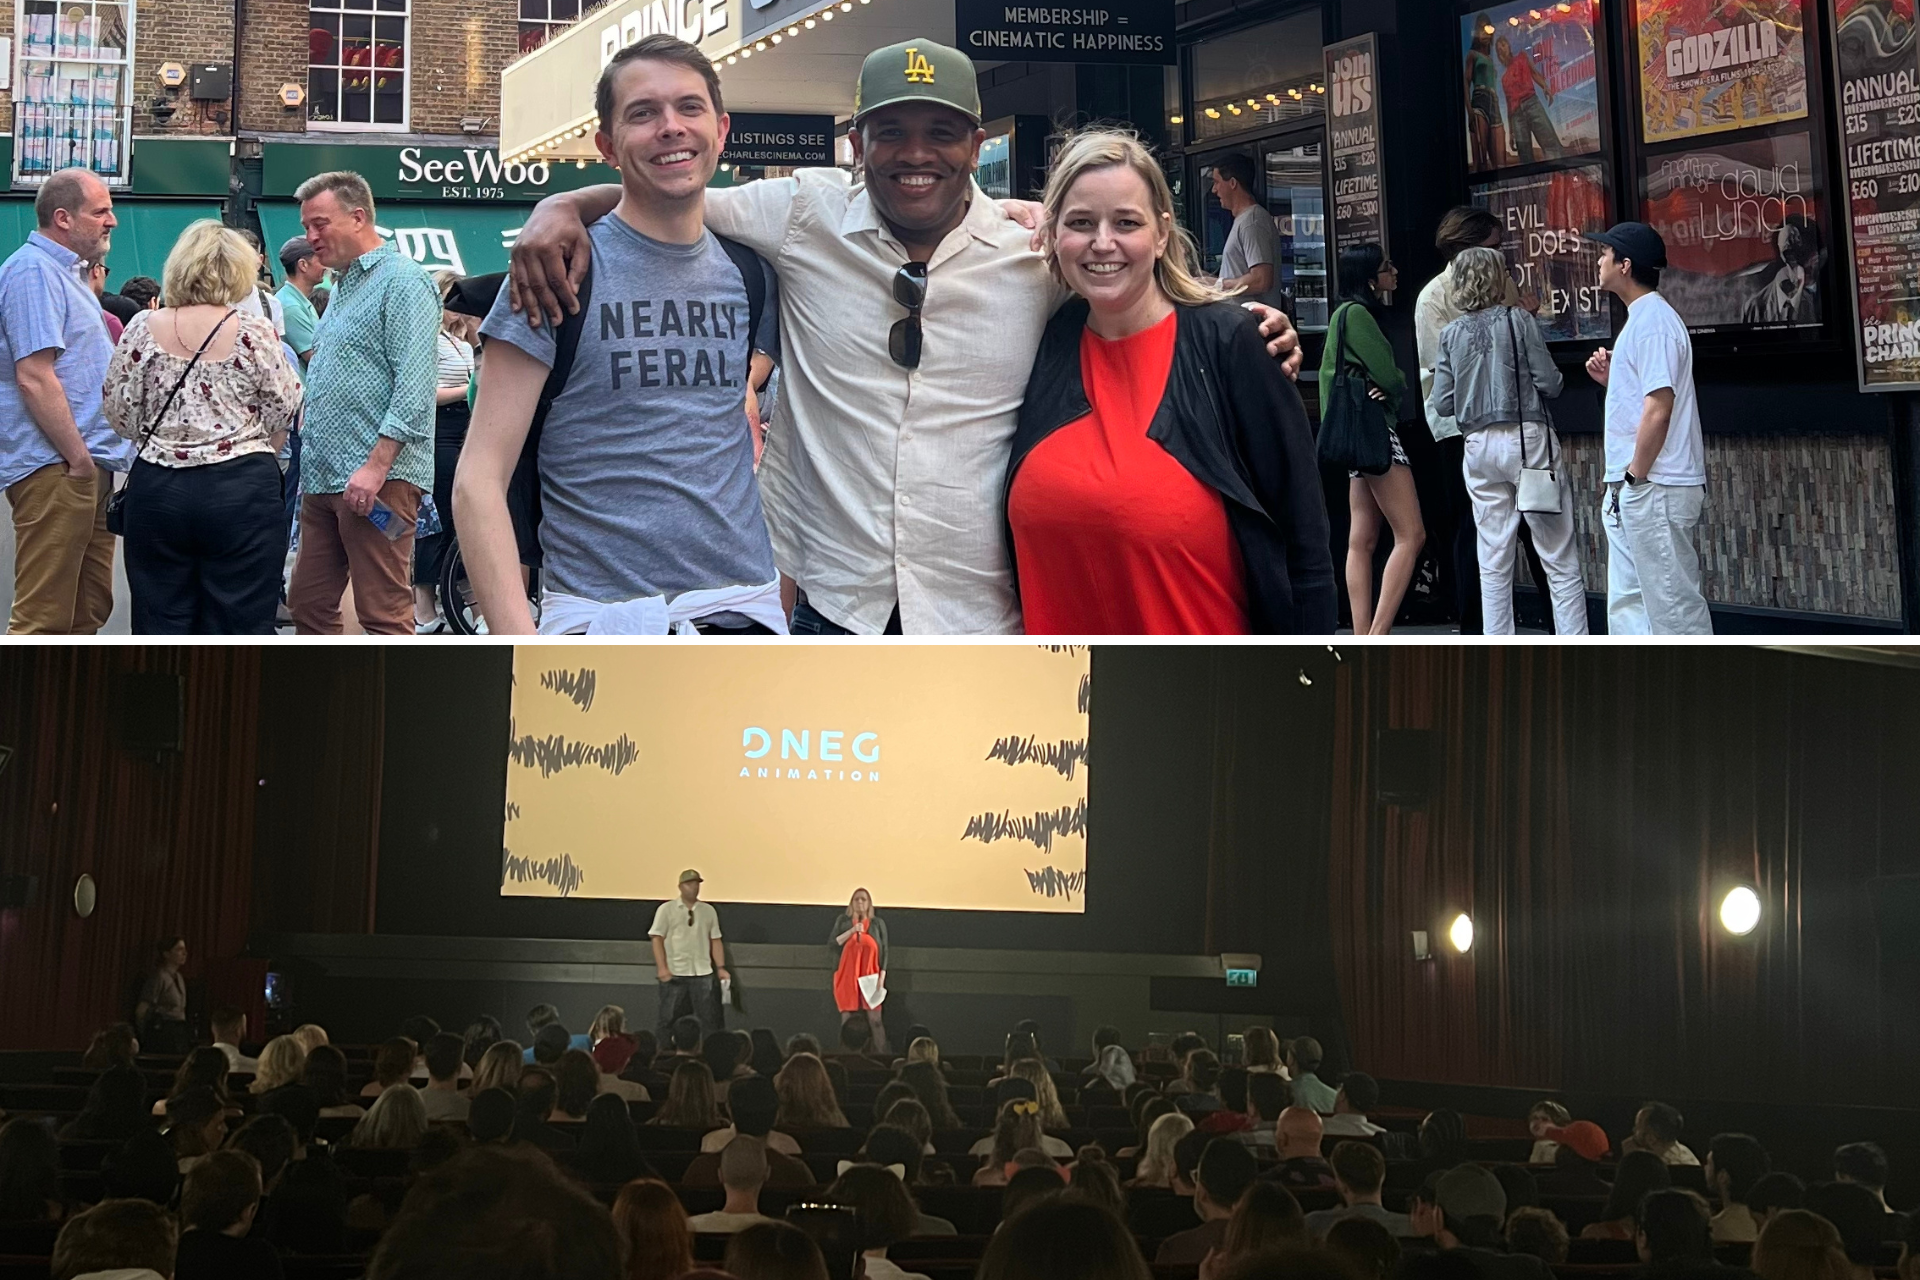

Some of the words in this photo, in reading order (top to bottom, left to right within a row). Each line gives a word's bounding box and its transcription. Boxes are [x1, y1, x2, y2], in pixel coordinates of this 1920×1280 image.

[1005, 7, 1109, 25] MEMBERSHIP
[970, 30, 1065, 49] CINEMATIC
[1073, 33, 1164, 51] HAPPINESS
[1666, 20, 1778, 78] GODZILLA
[904, 47, 935, 84] LA
[1667, 81, 1680, 91] THE
[1721, 69, 1741, 81] FILMS
[1843, 68, 1920, 104] ANNUAL
[1845, 114, 1869, 134] £15
[731, 133, 795, 145] LISTINGS
[799, 134, 825, 146] SEE
[1334, 125, 1376, 150] ANNUAL
[1333, 156, 1347, 171] £15
[1361, 150, 1376, 166] £20
[442, 187, 472, 198] EST.
[476, 187, 505, 199] 1975
[1335, 174, 1379, 196] LIFETIME
[1851, 179, 1879, 200] £60
[1336, 204, 1353, 219] £60
[1506, 203, 1545, 232] EVIL
[1528, 227, 1581, 258] DOES
[1514, 262, 1535, 288] OT
[1551, 285, 1601, 314] EXIST
[600, 300, 736, 341] NEARLY
[610, 349, 738, 390] FERAL.
[742, 726, 880, 763] DNEG
[739, 766, 880, 782] ANIMATION
